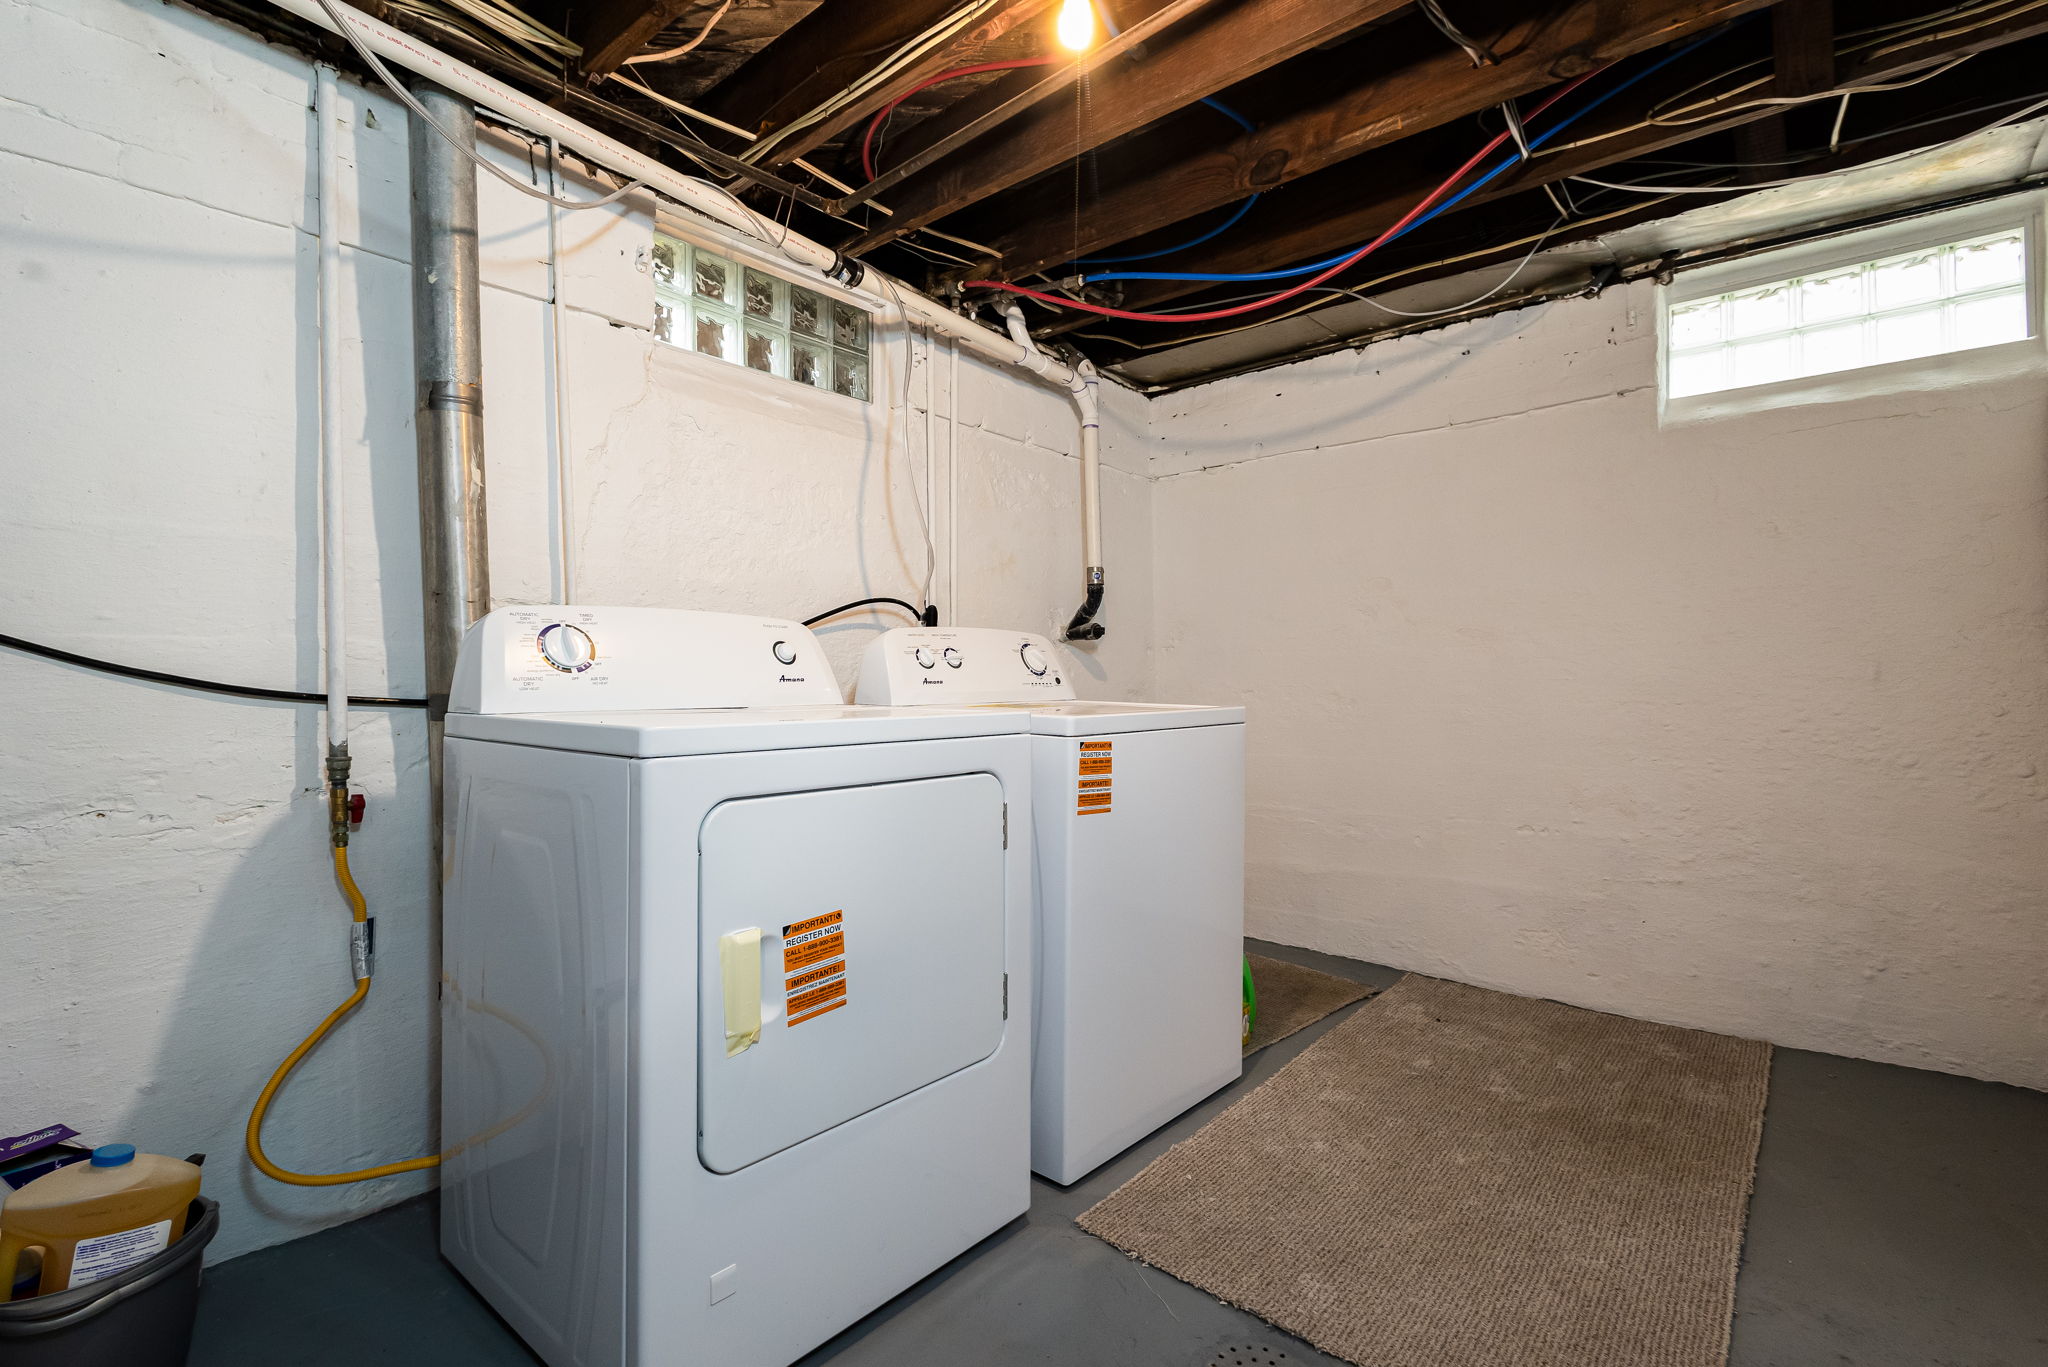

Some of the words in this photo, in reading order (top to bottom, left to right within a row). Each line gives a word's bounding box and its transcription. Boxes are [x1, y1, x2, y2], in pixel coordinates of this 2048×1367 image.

[779, 674, 805, 682] Amana
[922, 678, 944, 686] Amana
[792, 914, 836, 933] IMPORTANT!
[786, 930, 822, 947] REGISTER
[824, 924, 842, 935] NOW
[785, 947, 801, 958] CALL
[790, 964, 840, 988] IMPORTANTE!
[818, 972, 844, 986] MAINTENANT
